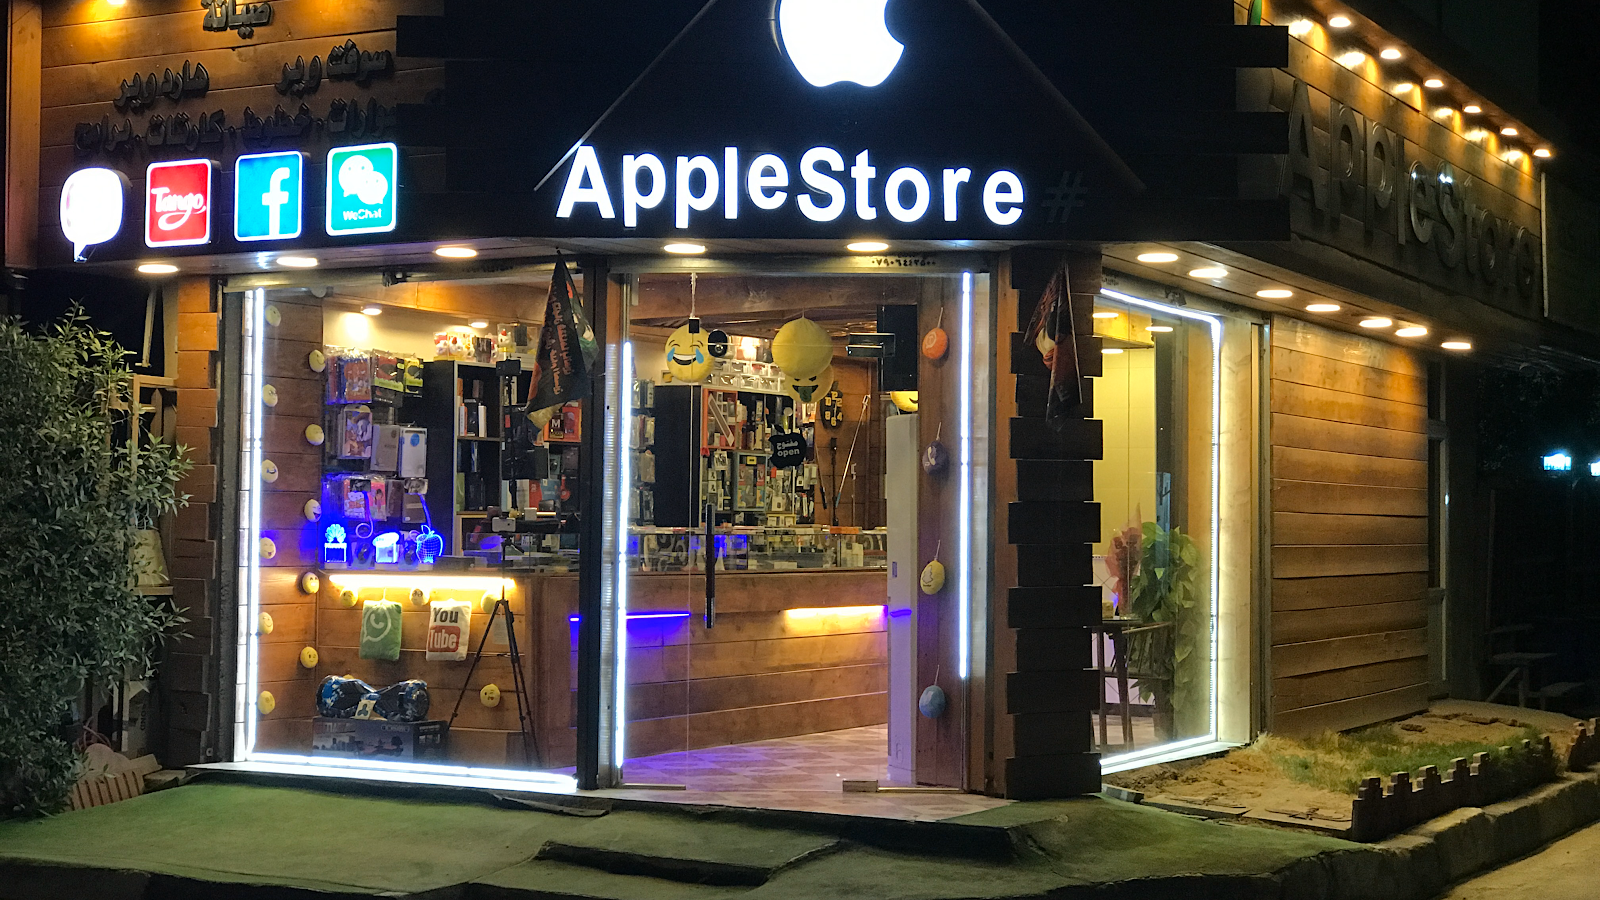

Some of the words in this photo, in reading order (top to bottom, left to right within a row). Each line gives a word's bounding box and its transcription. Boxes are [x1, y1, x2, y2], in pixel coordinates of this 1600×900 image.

[202, 0, 273, 38] صيانة
[151, 186, 206, 231] Tango
[343, 208, 382, 220] WeChat
[777, 449, 800, 457] open
[433, 607, 459, 623] You
[430, 629, 457, 649] Tube
